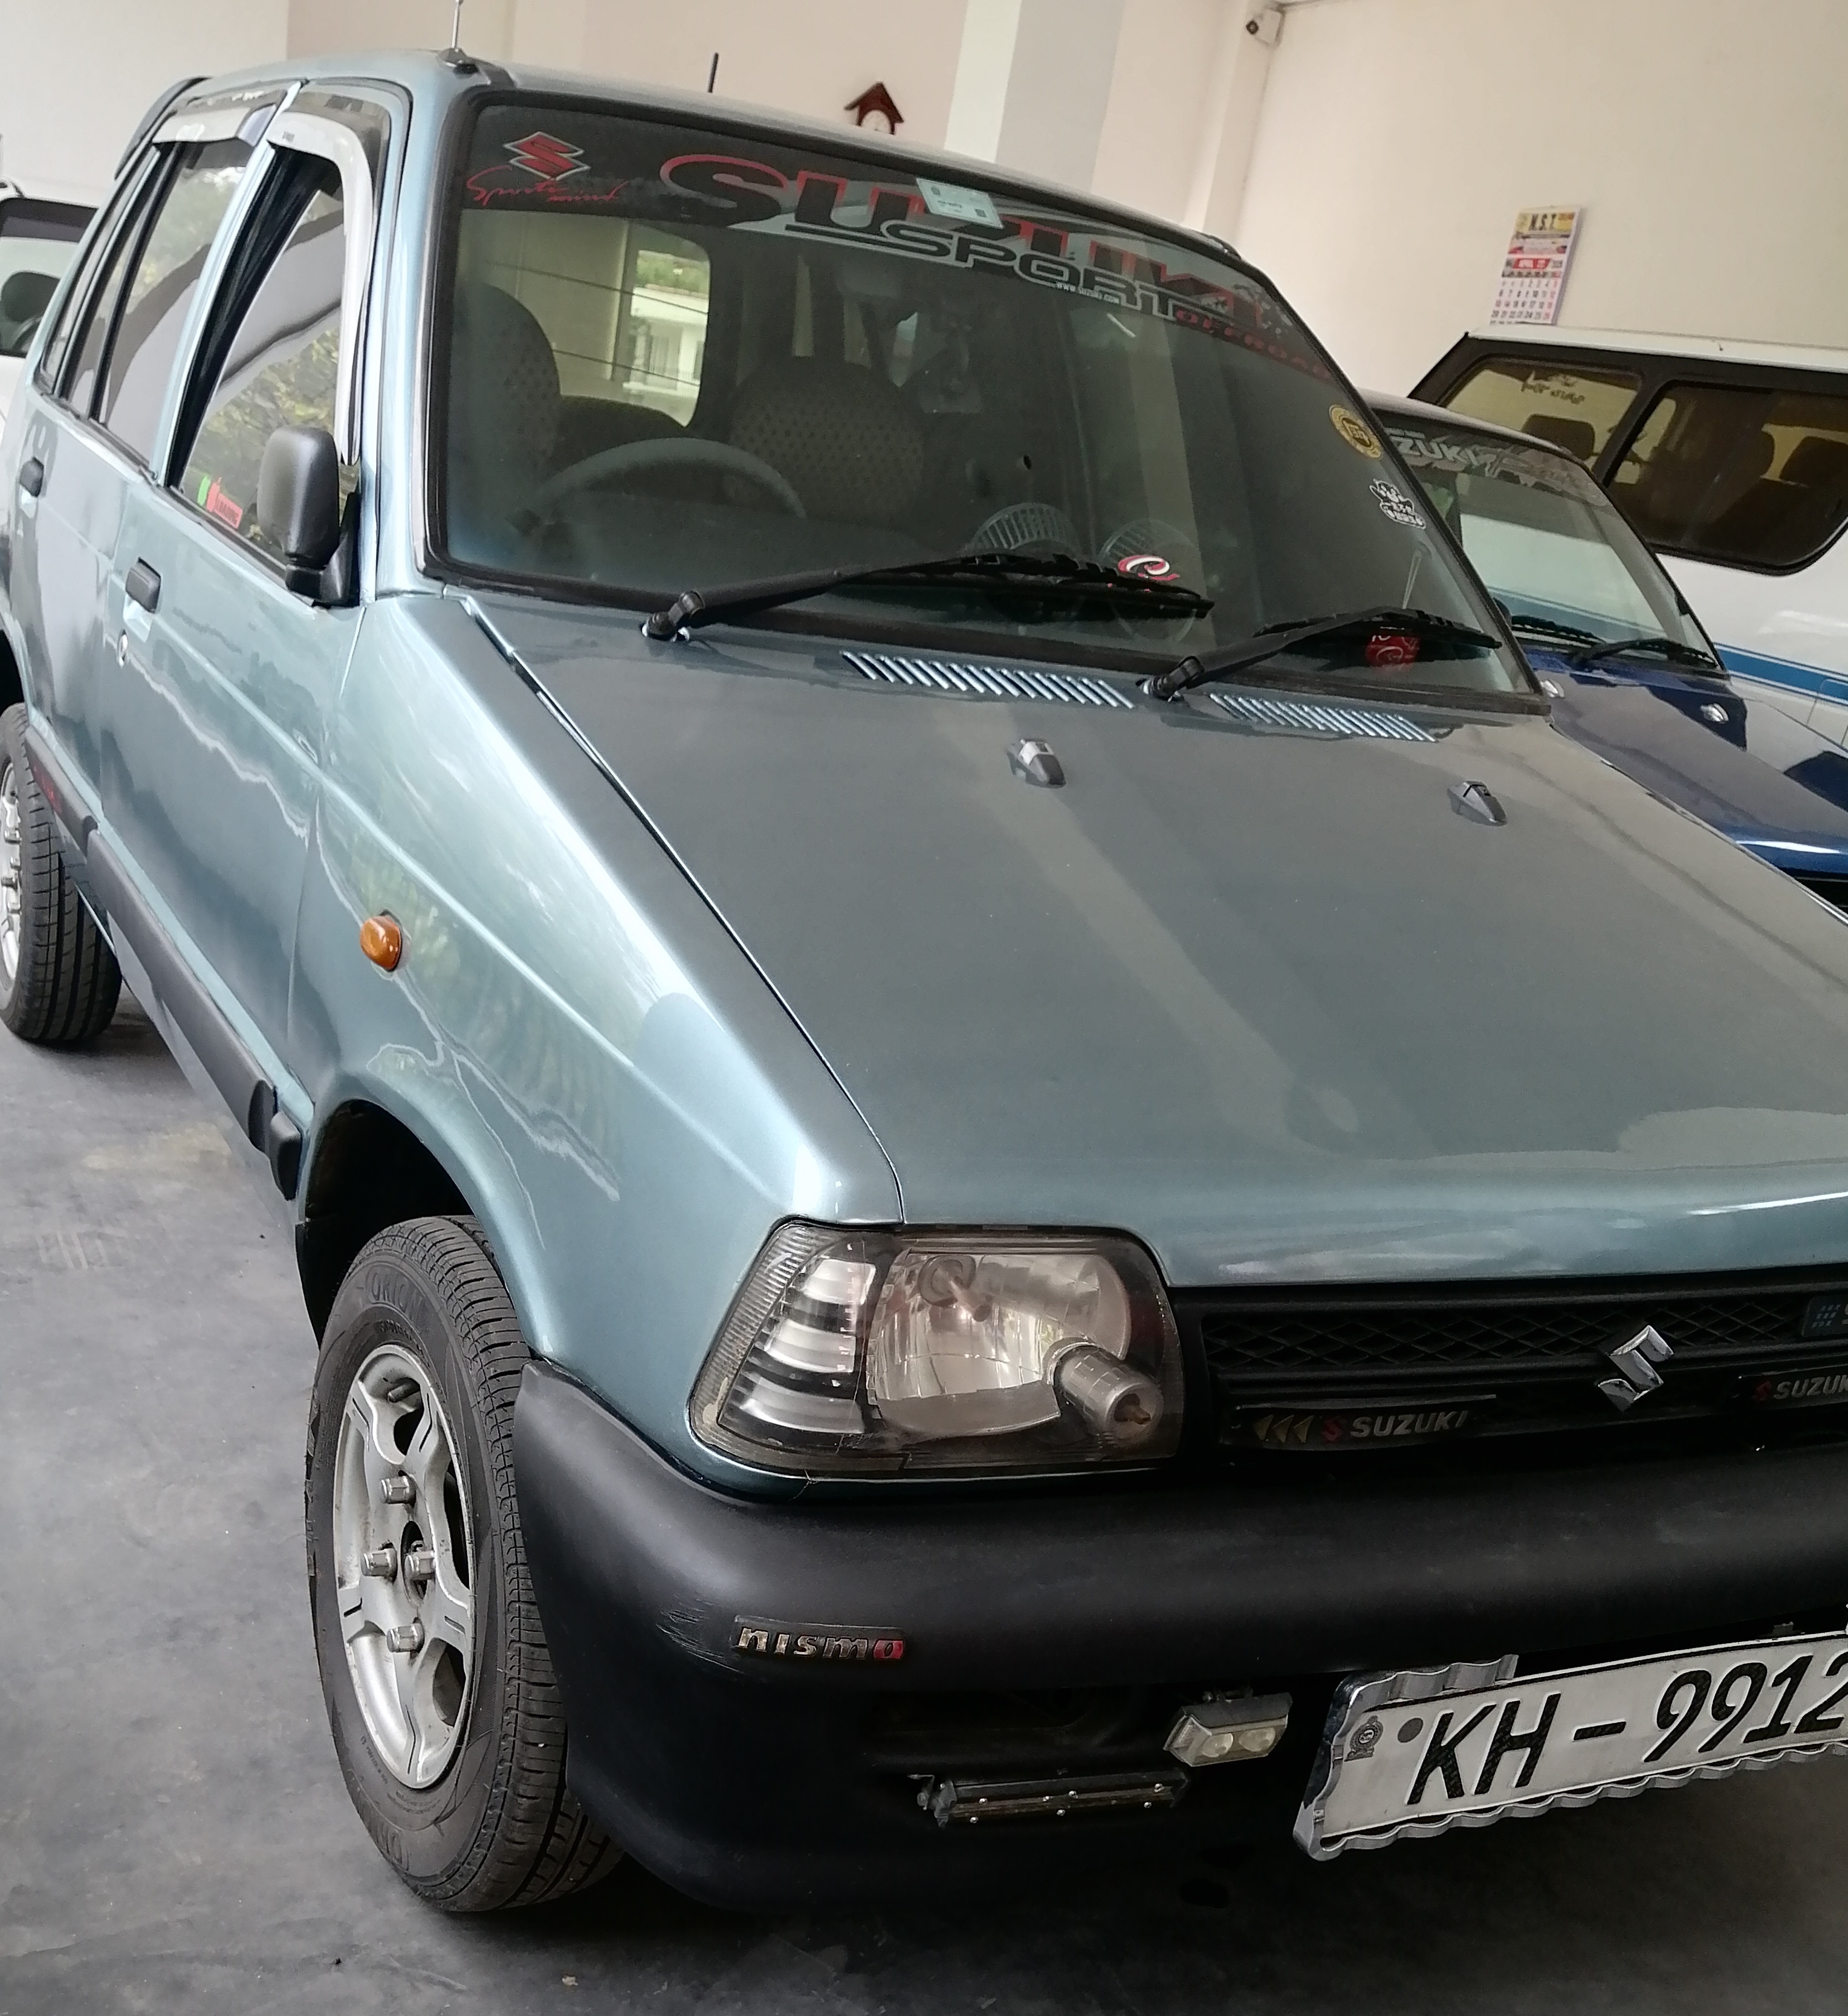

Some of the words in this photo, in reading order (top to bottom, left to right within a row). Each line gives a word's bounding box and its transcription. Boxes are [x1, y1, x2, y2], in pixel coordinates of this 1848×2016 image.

[880, 219, 1178, 322] SPORT
[1390, 435, 1479, 466] ZUKI
[1773, 1373, 1848, 1400] SUZUK
[1350, 1410, 1470, 1438] SUZUKI
[734, 1626, 905, 1660] nismo
